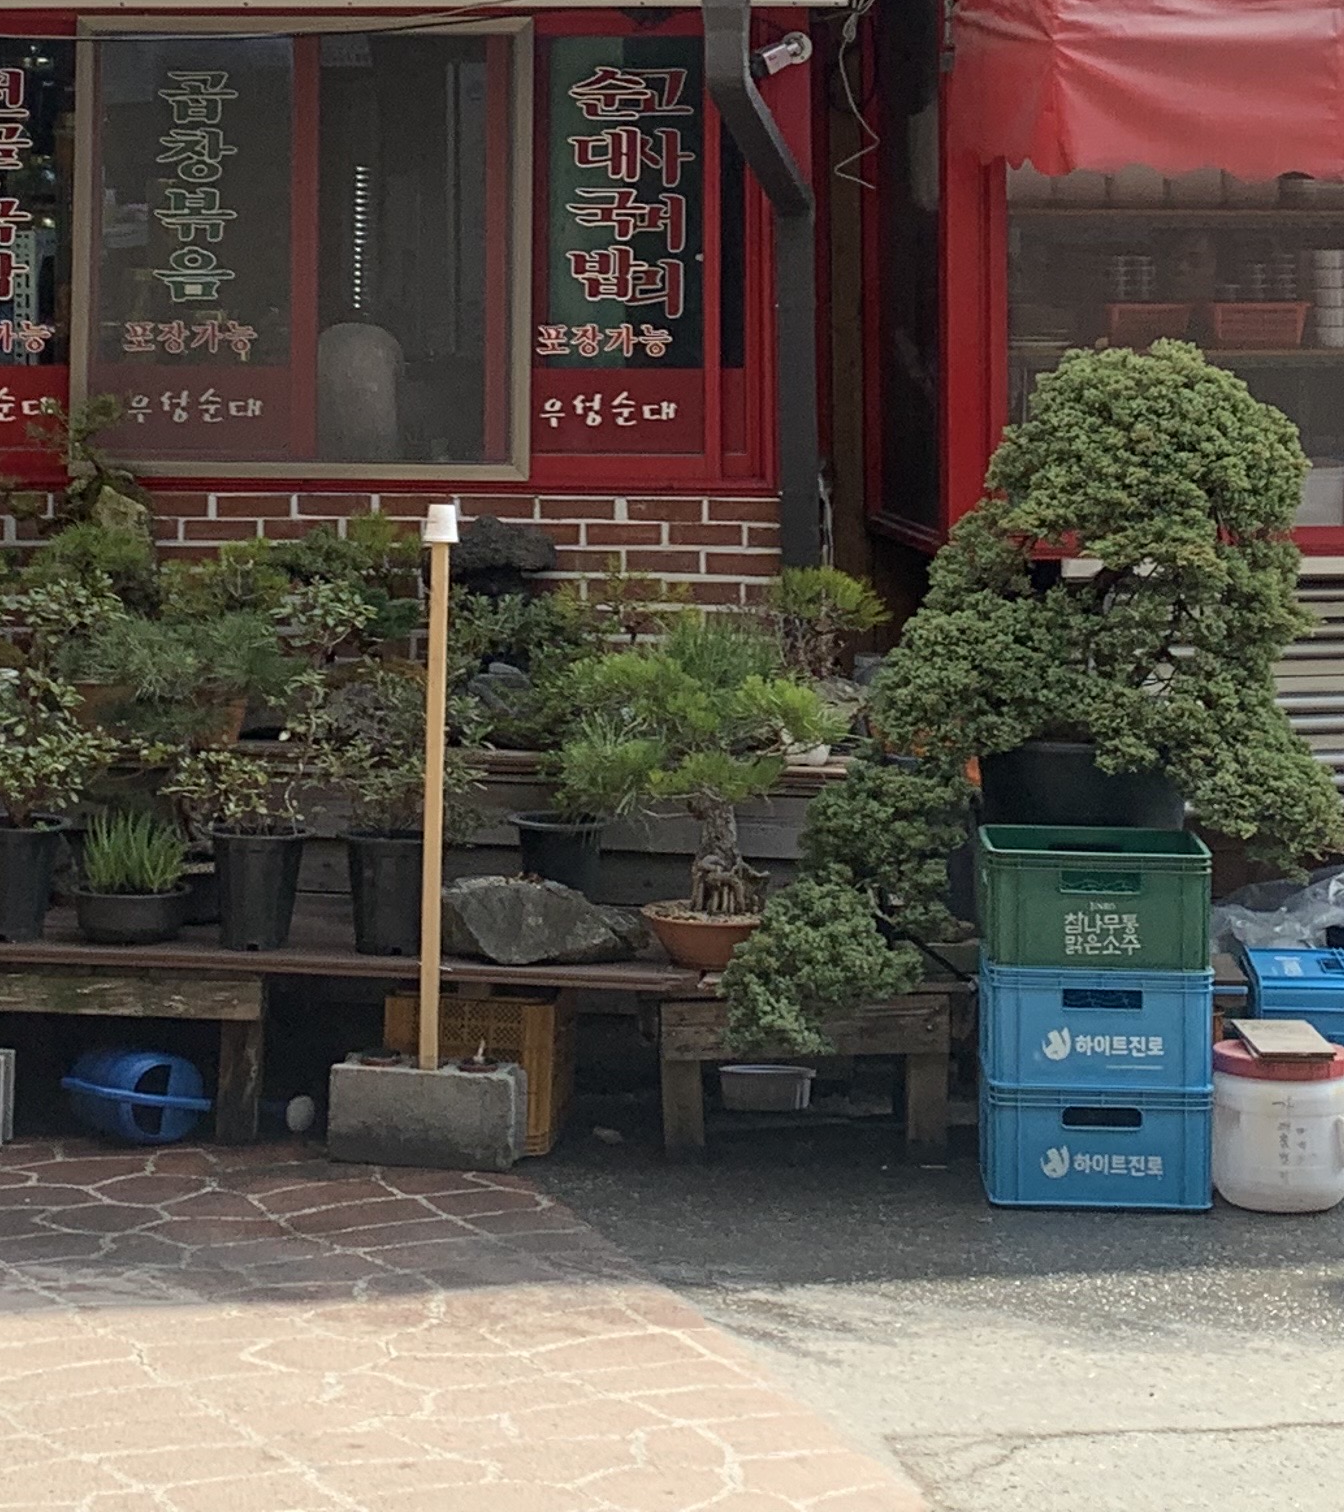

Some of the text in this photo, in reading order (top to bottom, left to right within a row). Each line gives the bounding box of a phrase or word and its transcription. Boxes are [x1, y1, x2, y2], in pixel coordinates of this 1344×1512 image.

[152, 70, 239, 303] 곱창볶음
[566, 66, 650, 302] 순대국밥
[123, 320, 258, 354] 포장가능
[535, 323, 673, 357] 포장가능
[127, 387, 263, 424] 우성순대
[539, 390, 678, 427] 우성순대
[1064, 911, 1140, 934] 참나무통
[1064, 934, 1142, 956] 맑은소주
[1074, 1033, 1165, 1058] 하이트진로
[1073, 1151, 1164, 1178] 하이트진로
